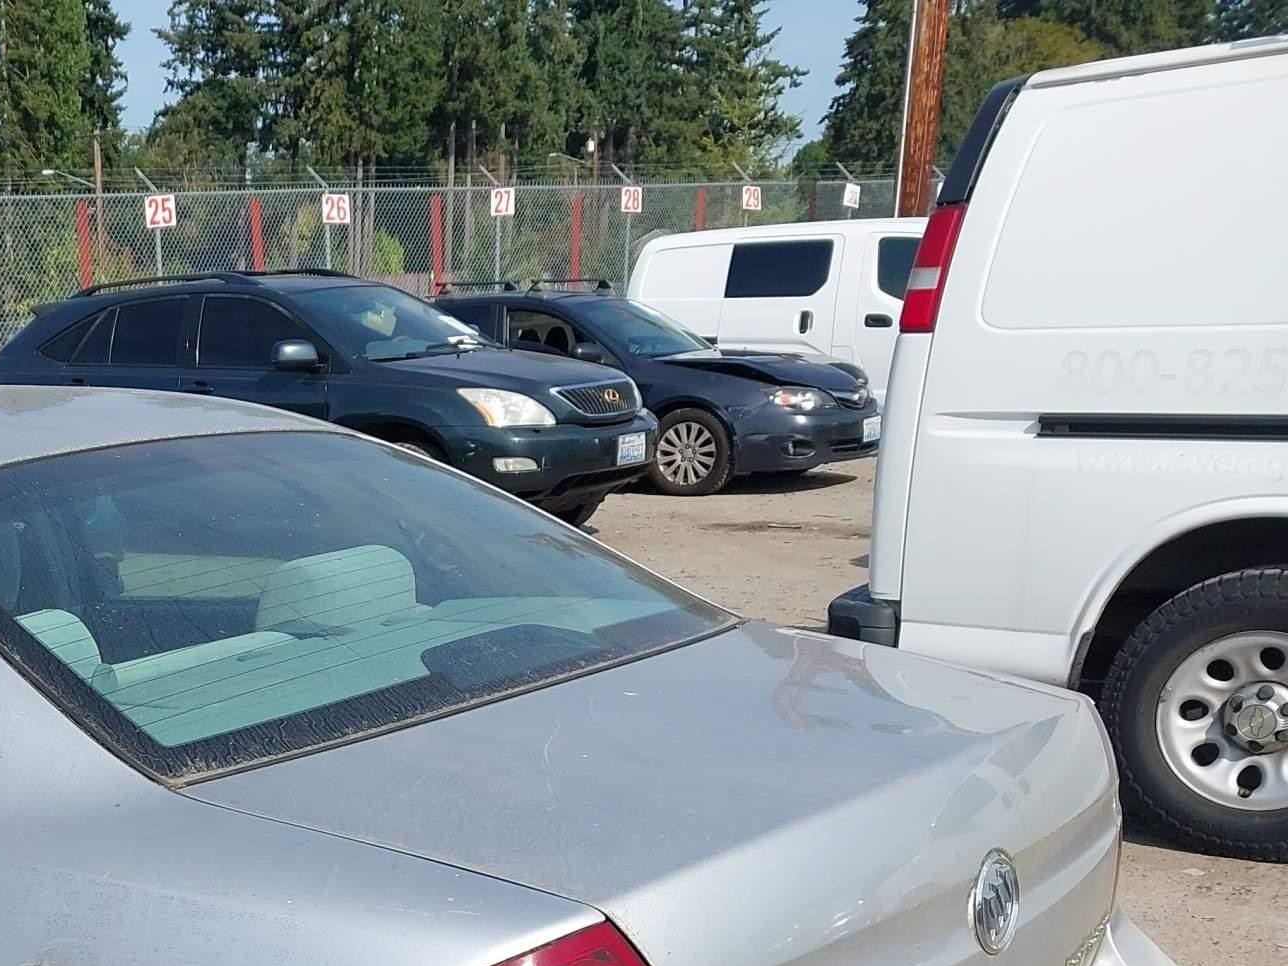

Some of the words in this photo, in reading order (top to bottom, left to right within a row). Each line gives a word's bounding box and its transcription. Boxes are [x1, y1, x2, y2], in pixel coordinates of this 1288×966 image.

[325, 196, 347, 221] 26
[495, 190, 510, 213] 27
[624, 189, 640, 210] 28
[745, 188, 759, 207] 29
[148, 197, 172, 225] 25
